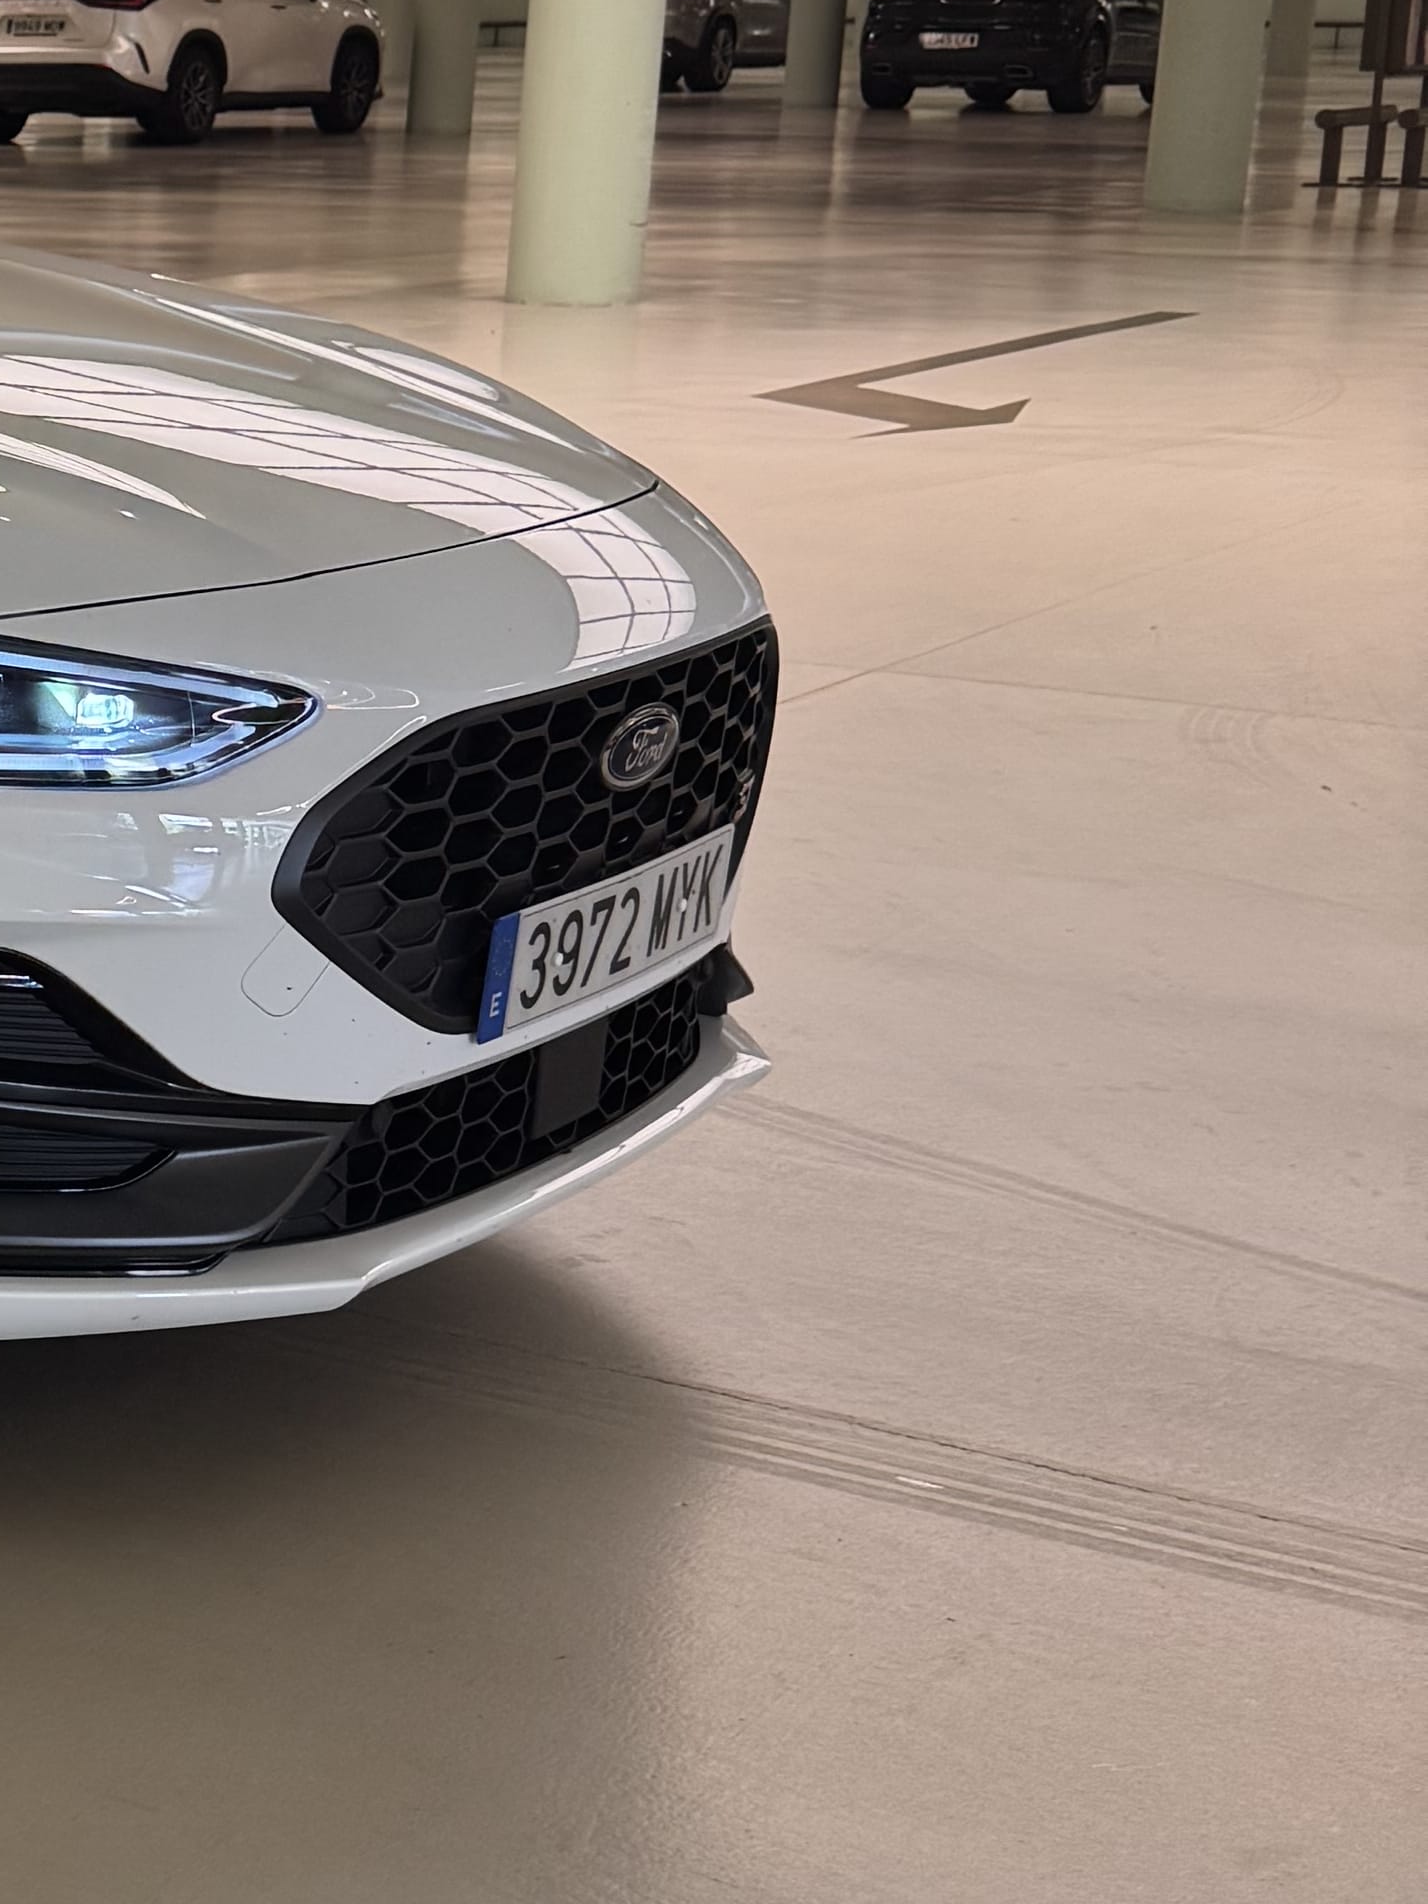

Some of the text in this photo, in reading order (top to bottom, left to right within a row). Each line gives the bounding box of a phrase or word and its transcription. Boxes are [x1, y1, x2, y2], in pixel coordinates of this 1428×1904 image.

[625, 726, 668, 773] Ford
[519, 843, 724, 1010] 3972 MYK
[489, 991, 503, 1019] E
